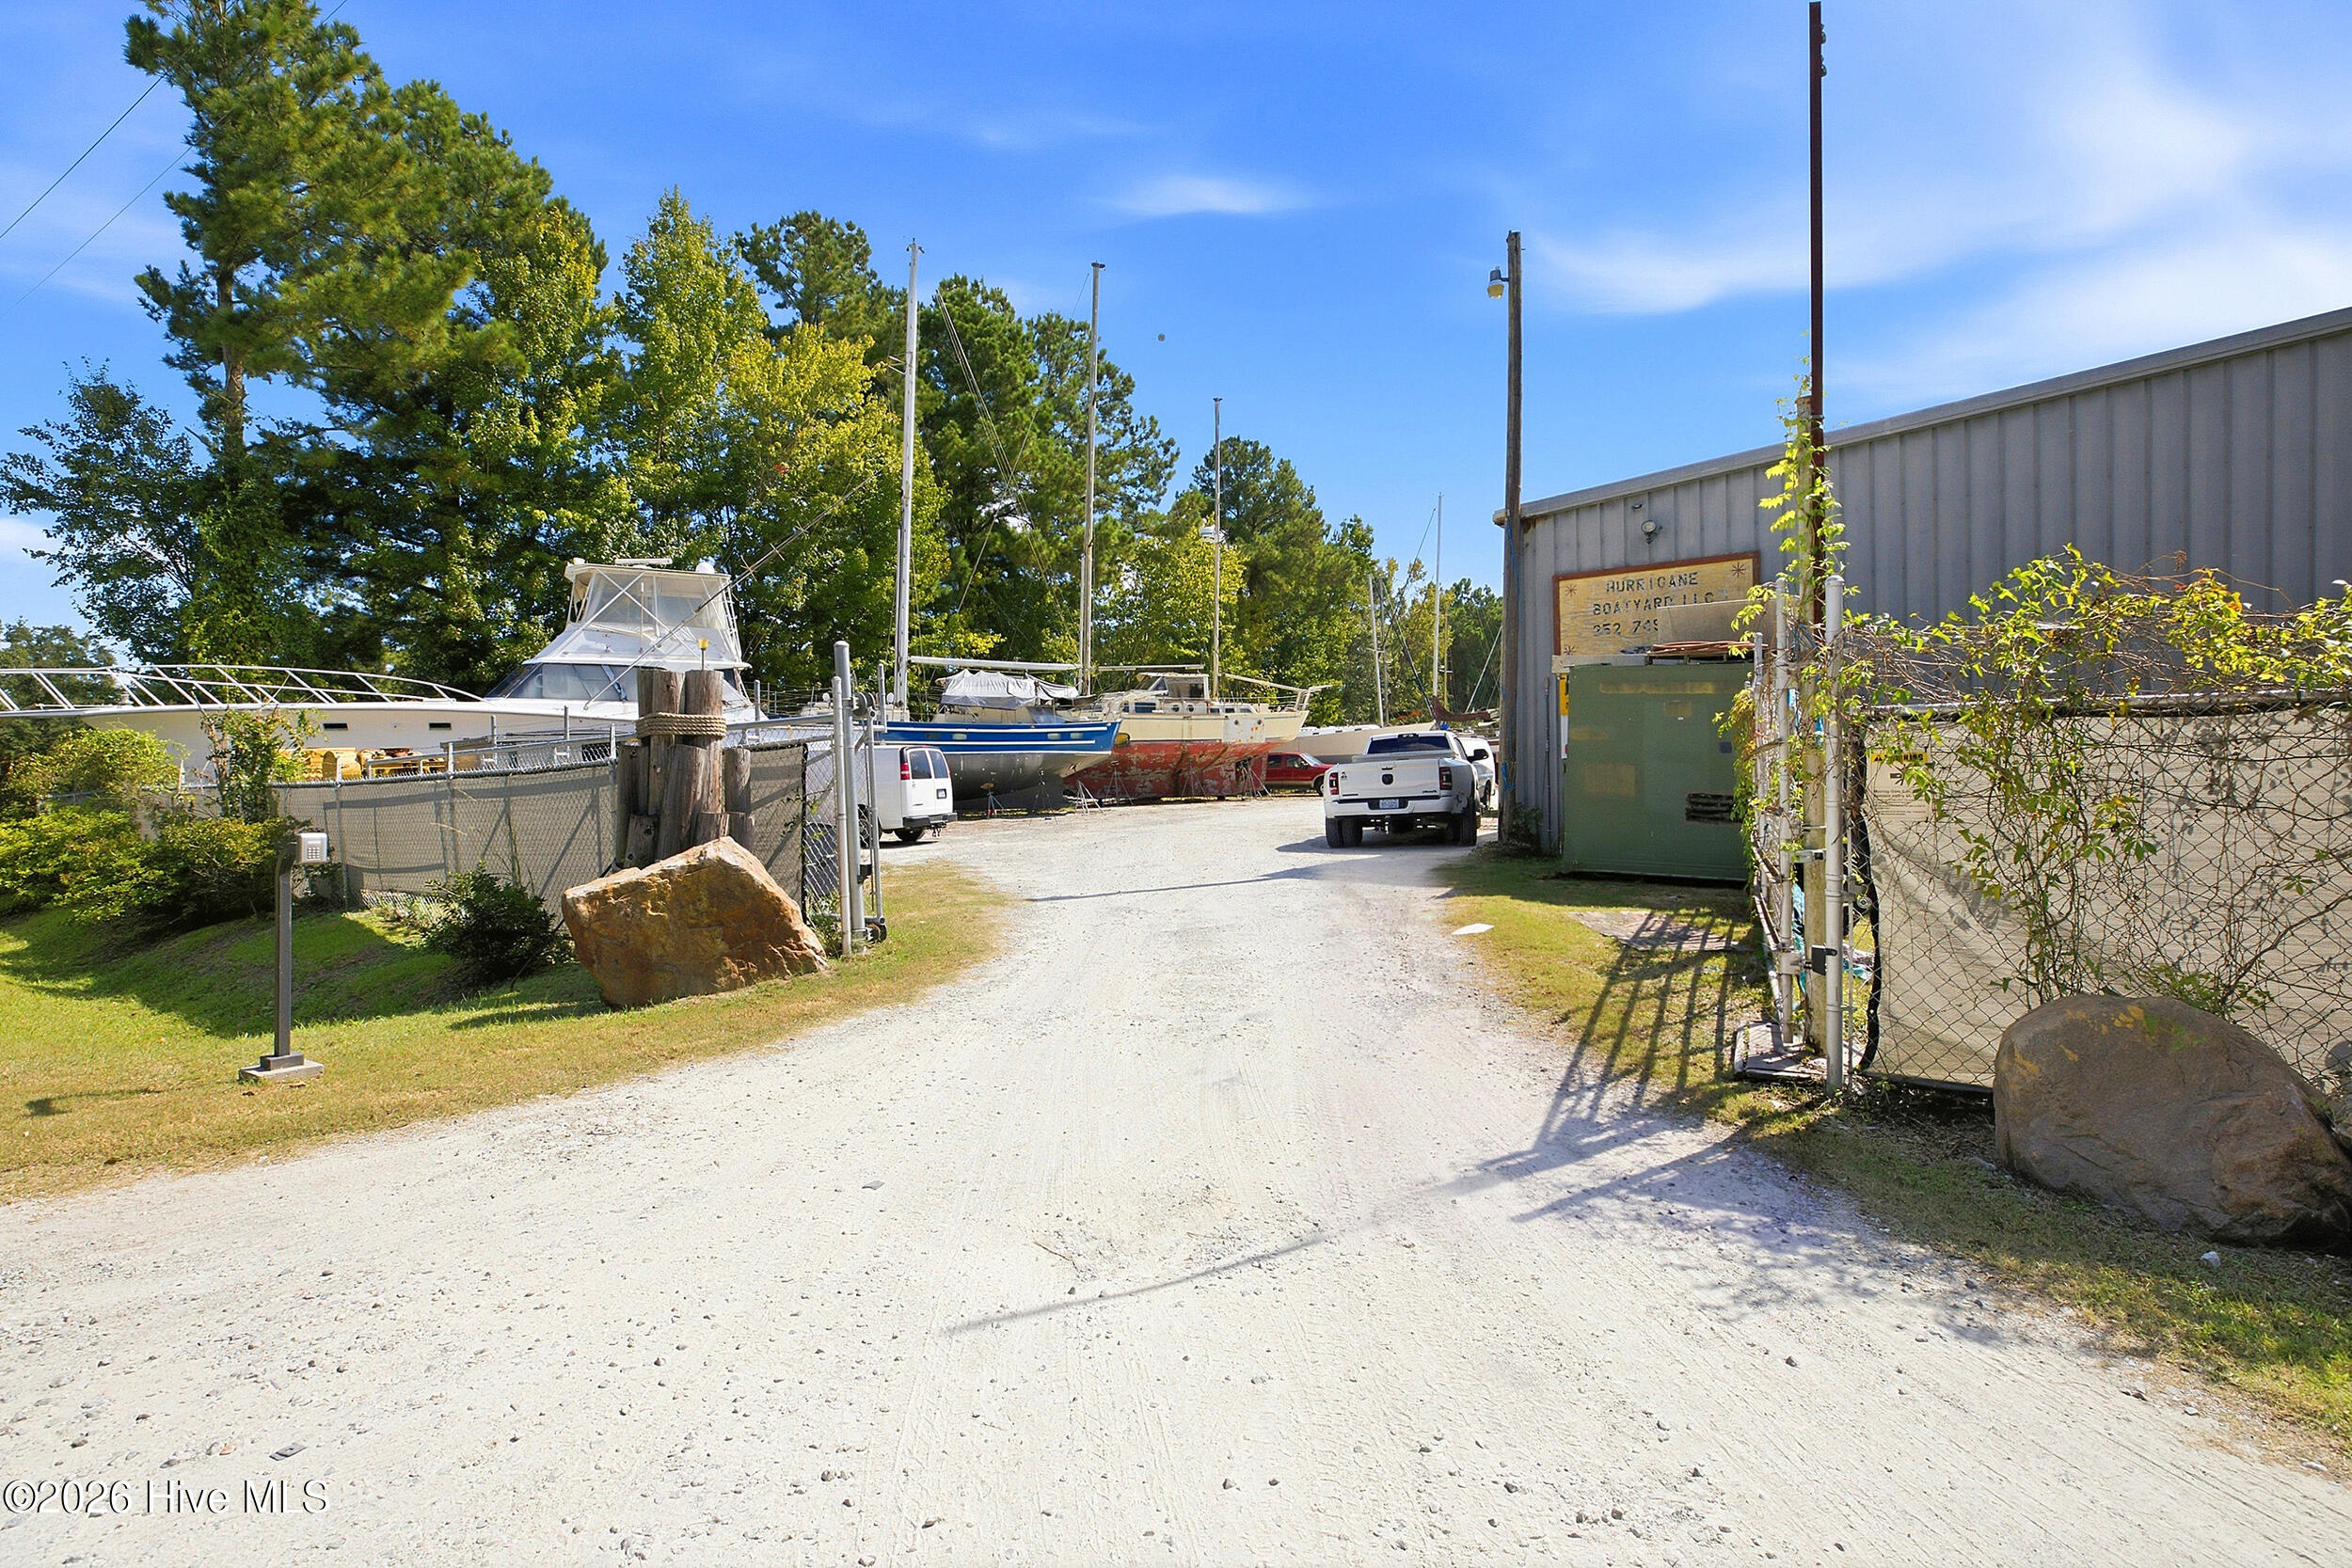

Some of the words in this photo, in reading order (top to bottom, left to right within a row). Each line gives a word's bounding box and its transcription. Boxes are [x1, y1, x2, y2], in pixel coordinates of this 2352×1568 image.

[1606, 572, 1698, 593] HURRICANE
[1593, 596, 1673, 615] BOATYARD
[1593, 623, 1621, 637] 252
